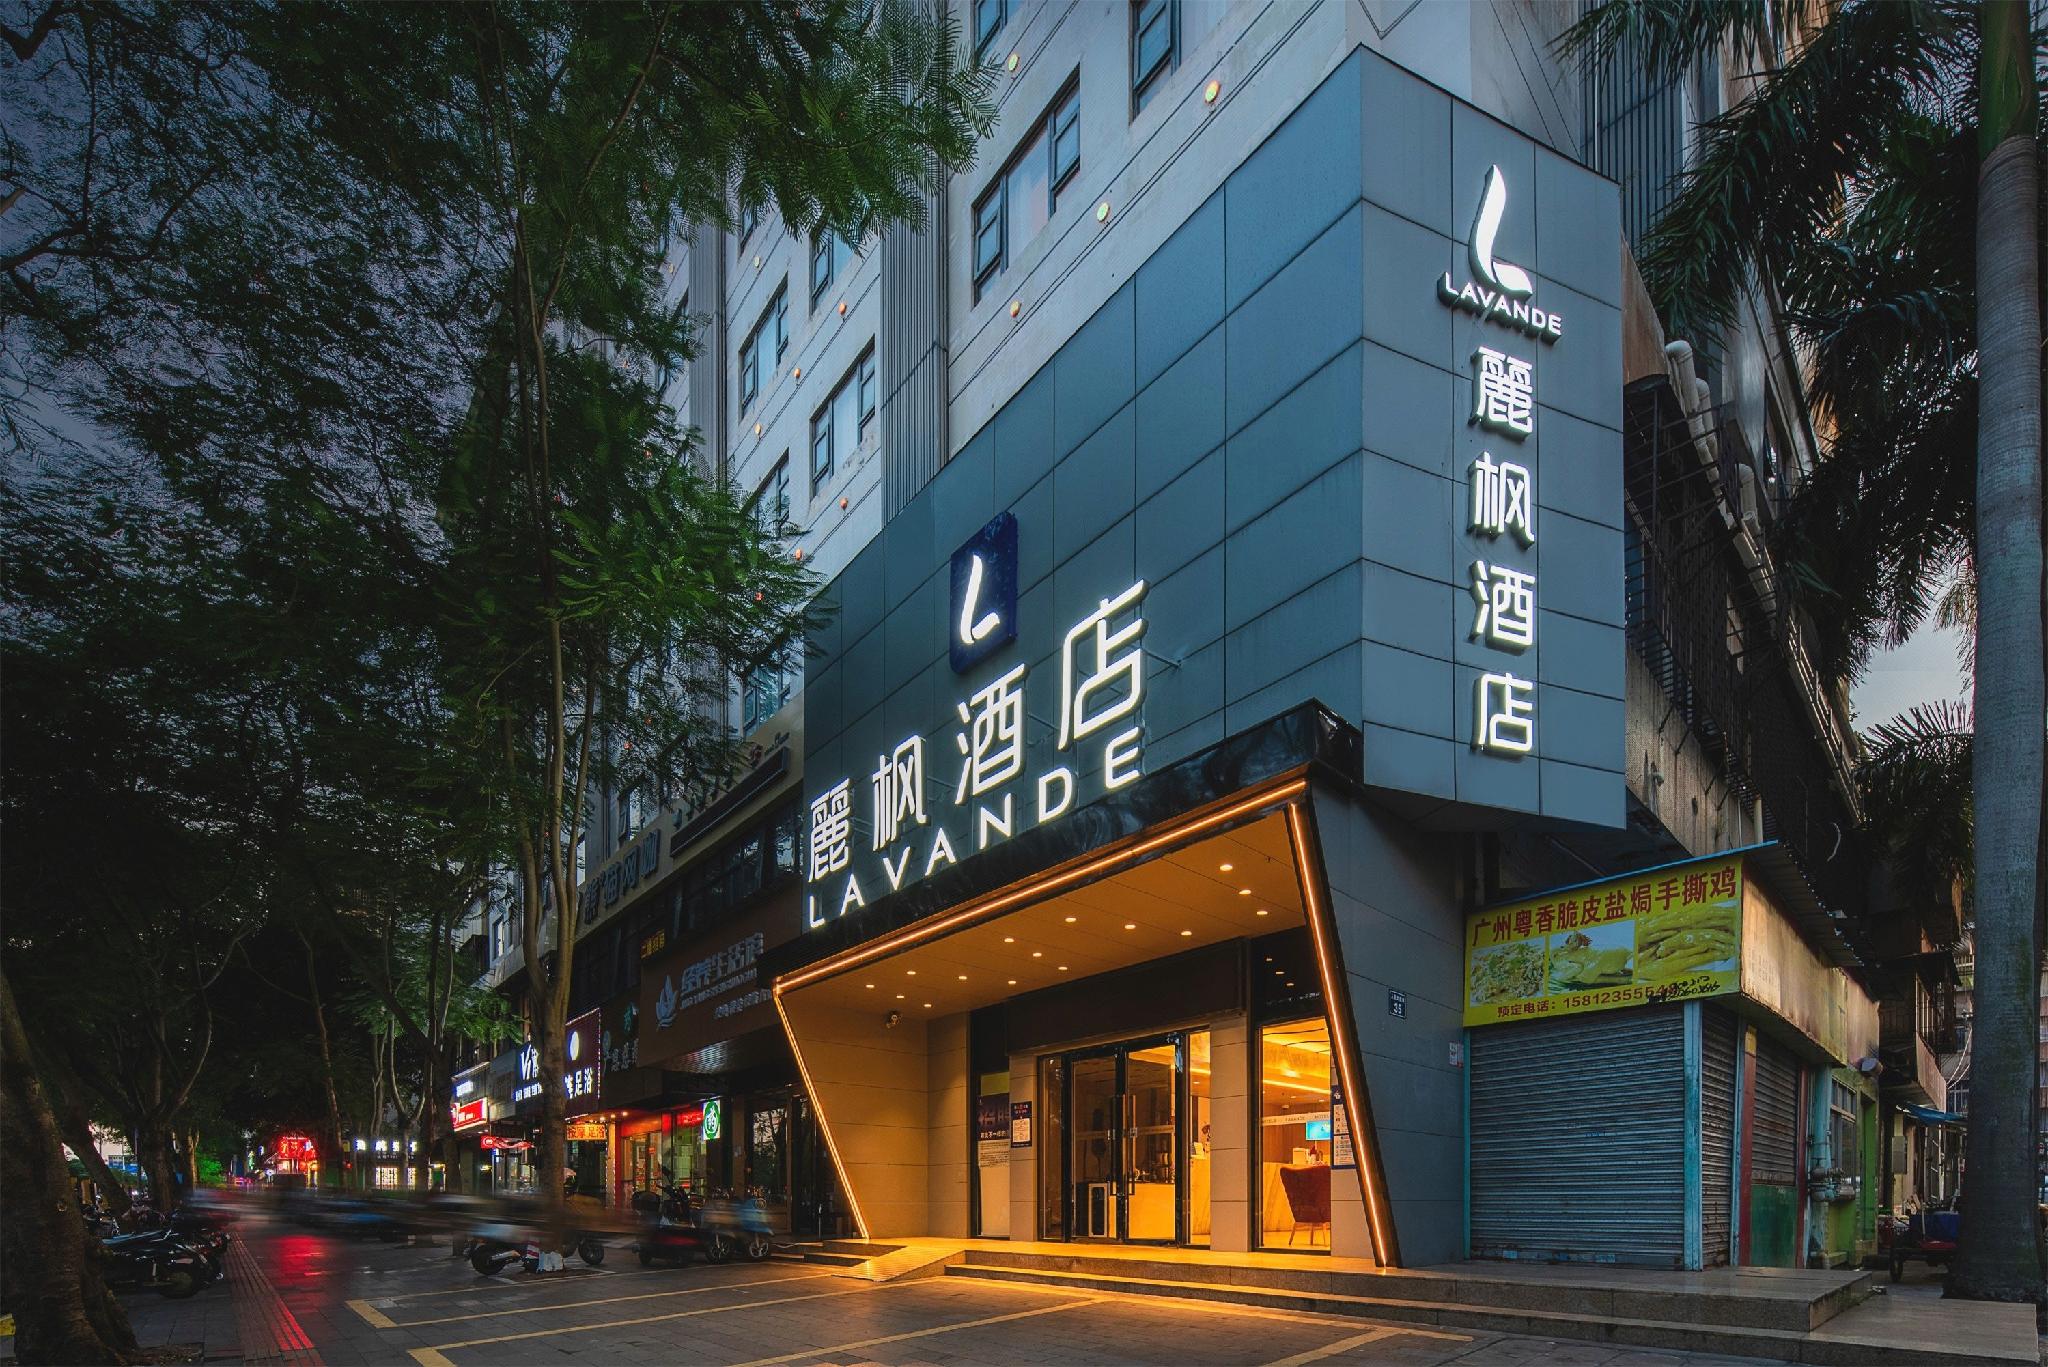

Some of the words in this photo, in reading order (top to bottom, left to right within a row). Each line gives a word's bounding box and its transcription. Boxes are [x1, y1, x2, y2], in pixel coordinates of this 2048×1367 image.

[1443, 270, 1563, 338] LAVANDE
[1474, 344, 1537, 752] 麗枫酒店
[808, 578, 1149, 883] 麗枫酒店
[808, 725, 1146, 929] LAVANDE
[1472, 865, 1737, 947] 广州粤香脆皮盐焗手撕鸡
